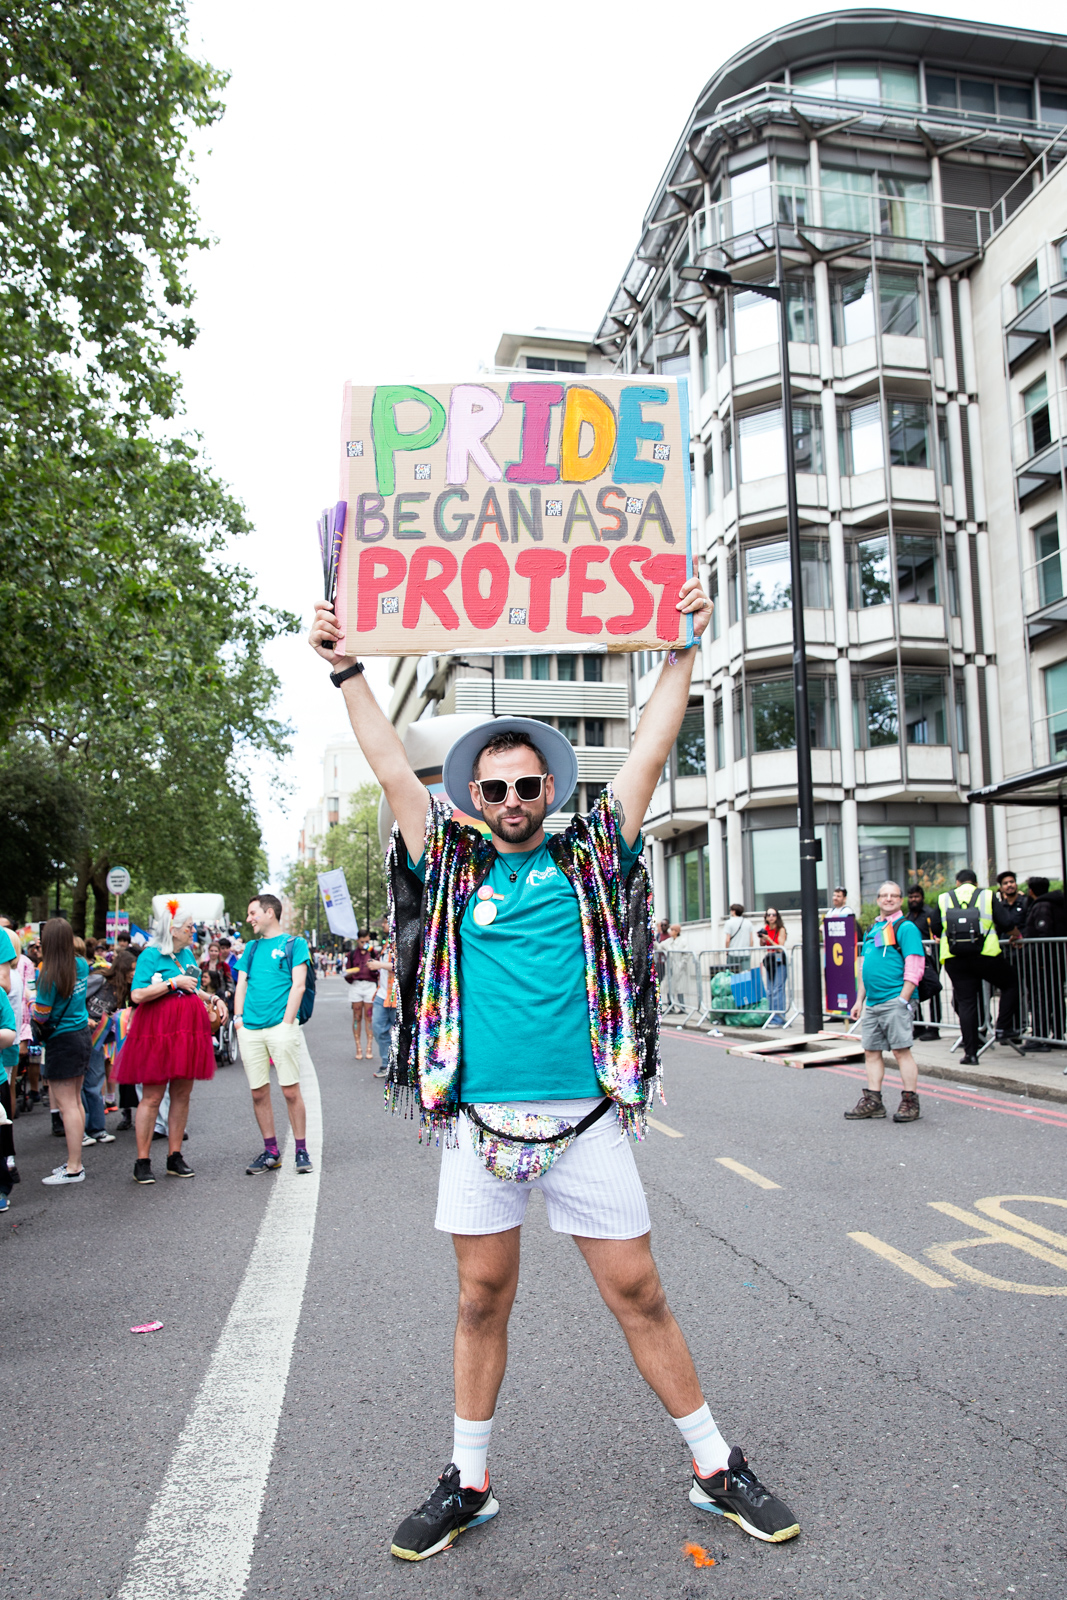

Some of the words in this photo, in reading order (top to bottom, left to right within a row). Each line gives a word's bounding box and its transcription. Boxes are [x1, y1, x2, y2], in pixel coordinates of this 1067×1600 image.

[371, 382, 669, 497] PRIDE
[355, 486, 545, 544] BEGAN
[563, 485, 629, 544] AS
[632, 489, 676, 545] A
[356, 542, 687, 641] PROTEST
[832, 942, 843, 966] C
